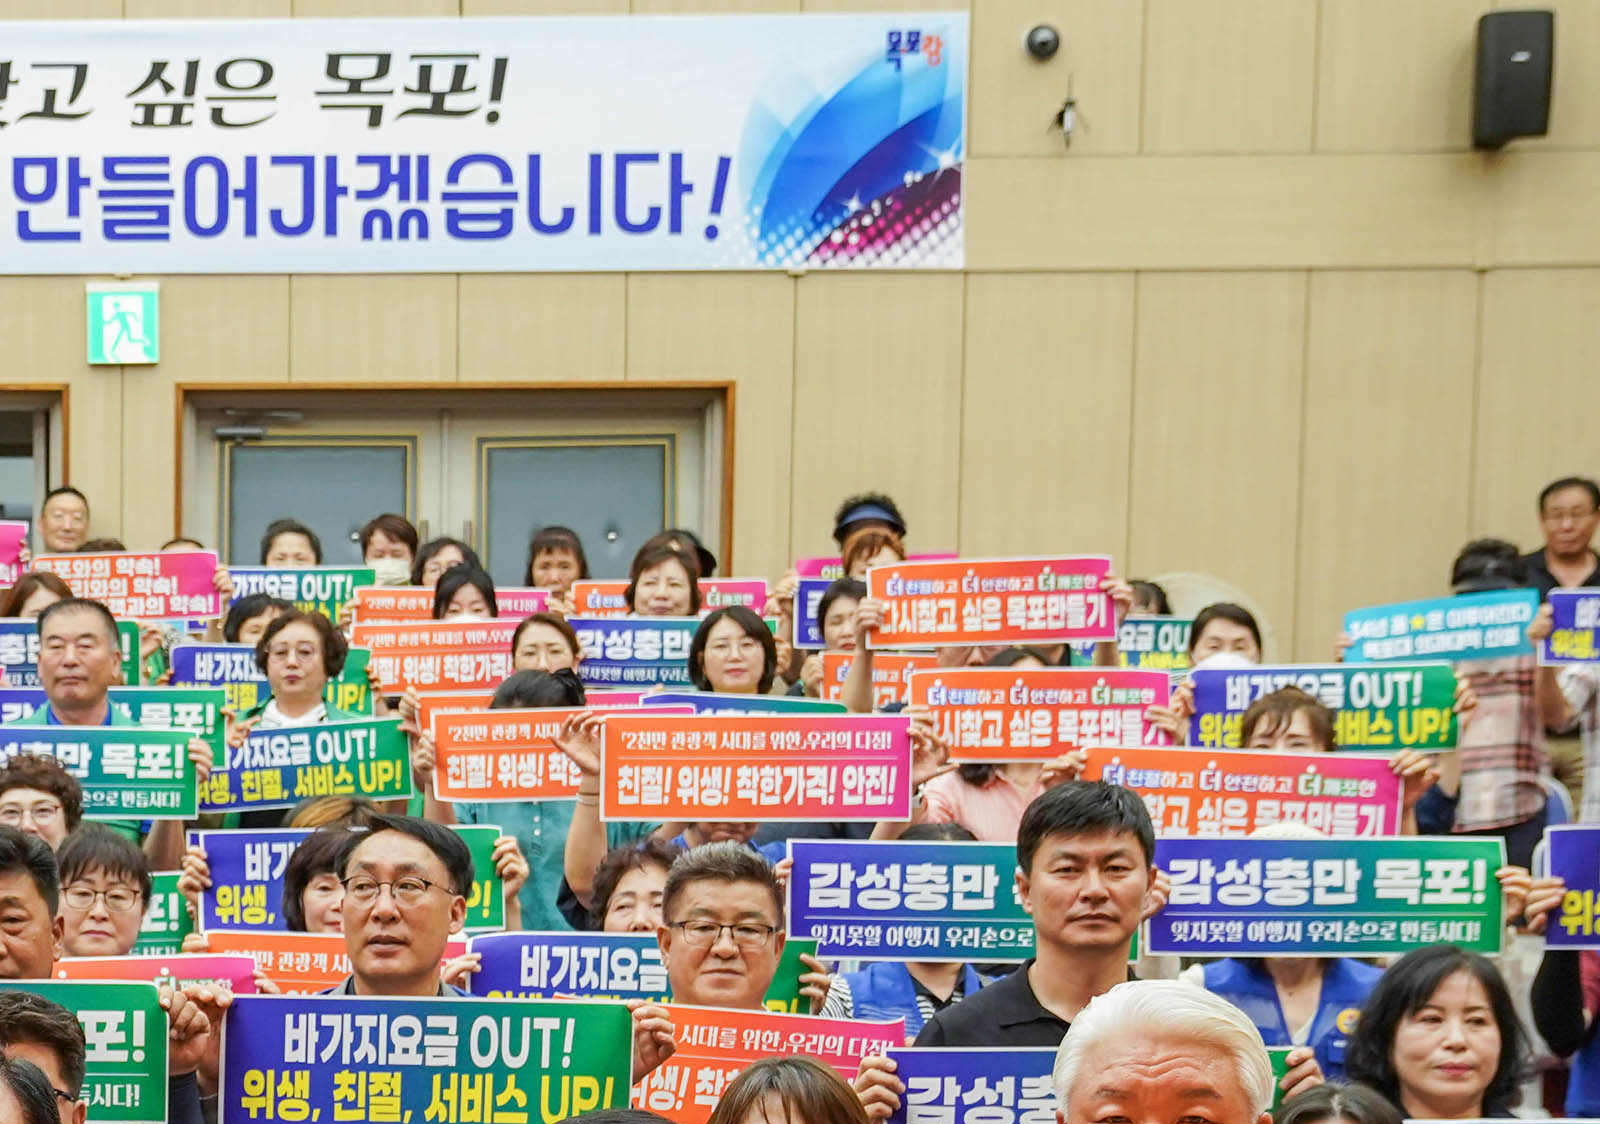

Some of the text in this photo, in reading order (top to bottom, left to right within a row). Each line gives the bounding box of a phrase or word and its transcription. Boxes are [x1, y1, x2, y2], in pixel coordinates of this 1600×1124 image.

[126, 58, 277, 128] 싶은
[314, 53, 509, 128] 목포!
[12, 153, 732, 242] 만들어가겠습니다!
[117, 557, 160, 577] 약속!
[133, 577, 177, 597] 약속!
[170, 595, 214, 615] 약속!
[302, 574, 353, 601] OUT!
[1007, 592, 1107, 630] 목포만들기
[578, 629, 692, 660] 감성충만
[1350, 672, 1423, 709] OUT!
[316, 727, 376, 762] OUT!
[1009, 709, 1052, 747] 싶은
[1398, 708, 1451, 745] UP!
[101, 742, 184, 780] 목포!
[241, 759, 403, 801] 친절, 서비스 UP!
[447, 754, 493, 789] 친절!
[497, 752, 543, 788] 위생!
[618, 765, 671, 805] 친절!
[677, 765, 732, 805] 위생!
[736, 765, 835, 806] 착한가격!
[842, 765, 896, 805] 안전!
[808, 861, 999, 912] 감성충만
[1169, 857, 1487, 906] 감성충만 목포!
[215, 884, 276, 924] 위생,
[886, 925, 940, 949] 여행지
[945, 925, 1033, 948] 우리손으로
[1247, 920, 1301, 943] 여행지
[1307, 920, 1398, 943] 우리손으로
[520, 943, 668, 992] 바가지요금
[283, 1012, 576, 1069] 바가지요금 OUT!
[678, 1022, 740, 1049] 시대를
[240, 1069, 321, 1123] 위생,
[332, 1070, 412, 1124] 친절,
[424, 1072, 529, 1124] 서비스
